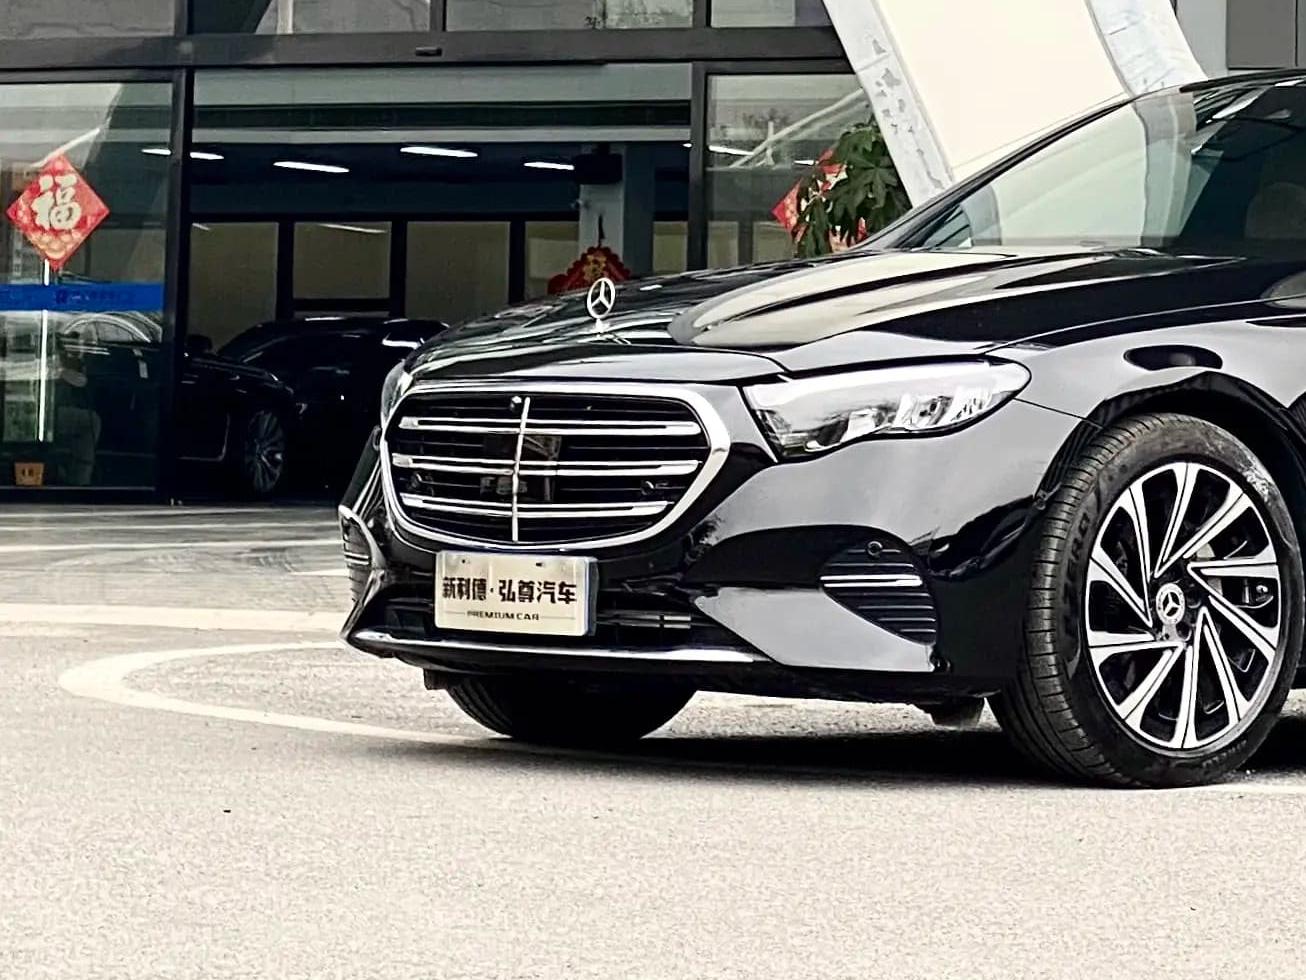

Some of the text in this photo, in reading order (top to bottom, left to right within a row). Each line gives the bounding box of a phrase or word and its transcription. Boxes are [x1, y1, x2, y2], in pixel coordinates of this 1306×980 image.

[31, 173, 82, 231] 福
[466, 610, 540, 621] PREMIUM CAR
